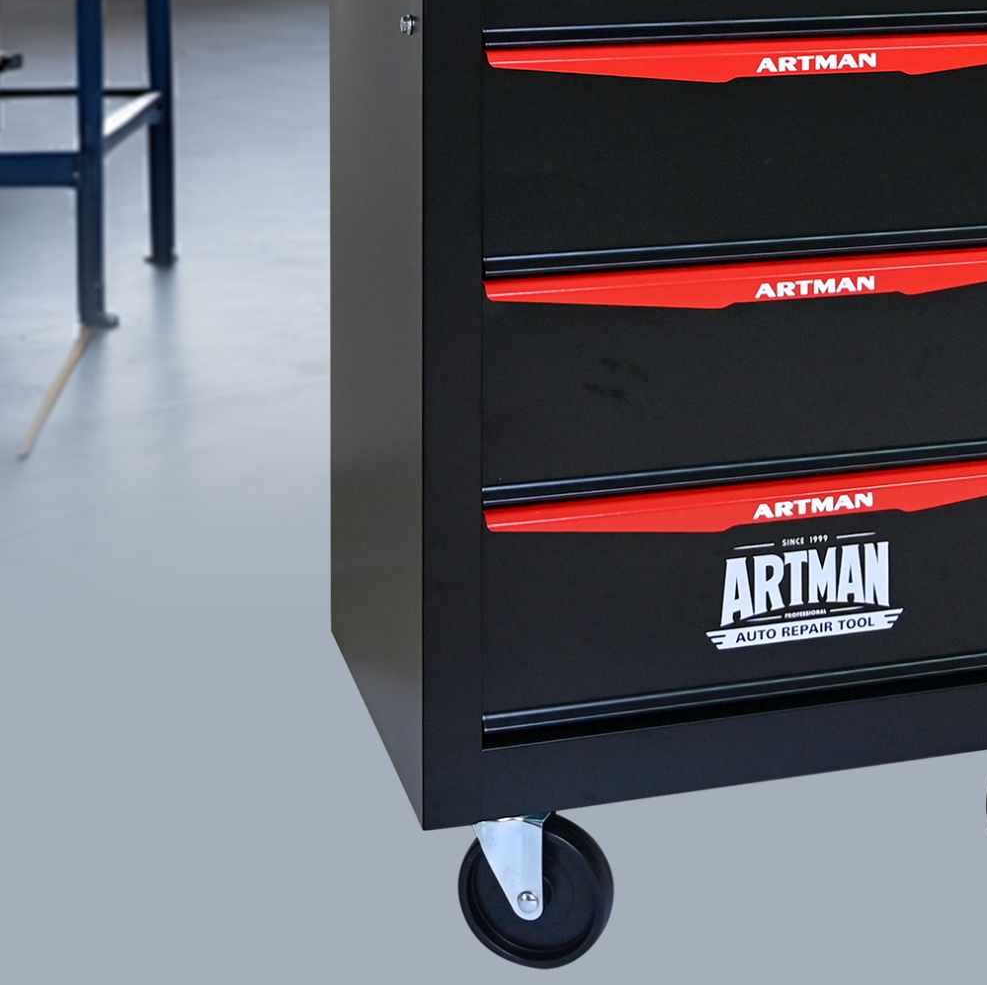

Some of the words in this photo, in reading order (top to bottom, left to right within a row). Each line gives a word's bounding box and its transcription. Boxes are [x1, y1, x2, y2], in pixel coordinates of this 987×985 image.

[756, 52, 877, 73] ARTMAN
[755, 275, 875, 299] ARTMAN
[753, 492, 873, 520] ARTMAN
[782, 536, 805, 547] SINCE
[809, 534, 829, 545] 1999
[720, 540, 890, 627] ARTMAN
[784, 608, 827, 619] PROFESSIONAL
[736, 629, 777, 644] AUTO
[781, 620, 834, 639] REPAIR
[837, 616, 876, 631] TOOL
